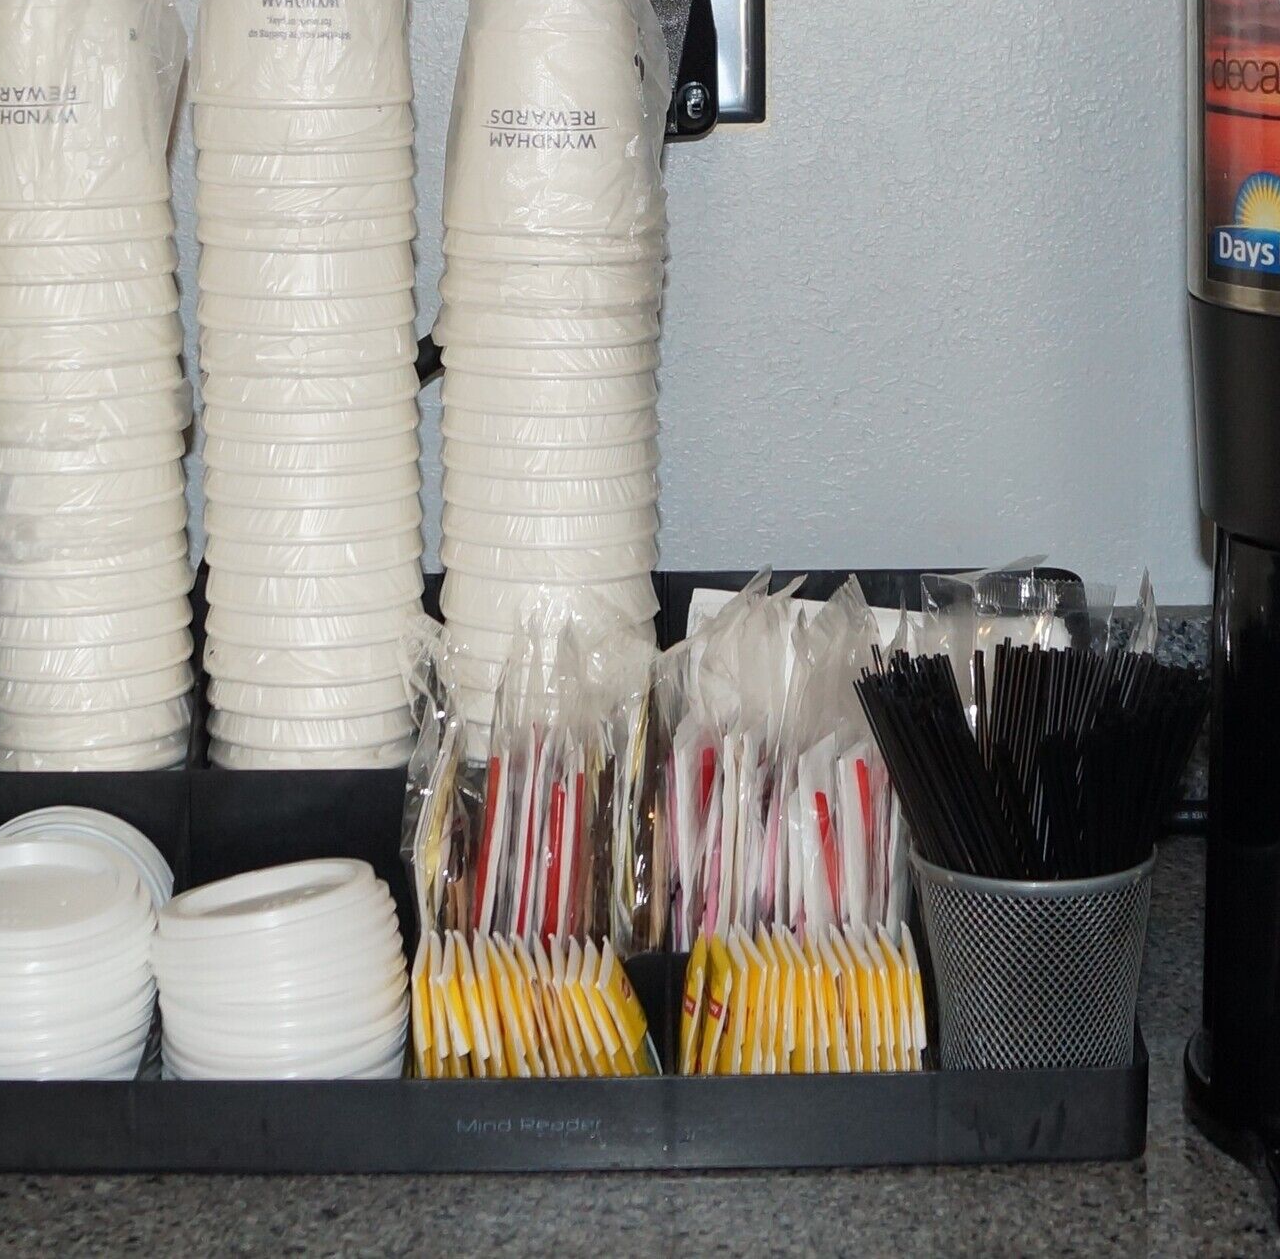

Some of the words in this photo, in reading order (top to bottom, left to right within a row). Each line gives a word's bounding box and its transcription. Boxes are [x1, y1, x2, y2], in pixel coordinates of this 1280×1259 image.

[489, 132, 597, 150] WYNDHAM
[1219, 231, 1275, 268] Days
[456, 1118, 512, 1134] Mind
[519, 1116, 602, 1135] Reader
